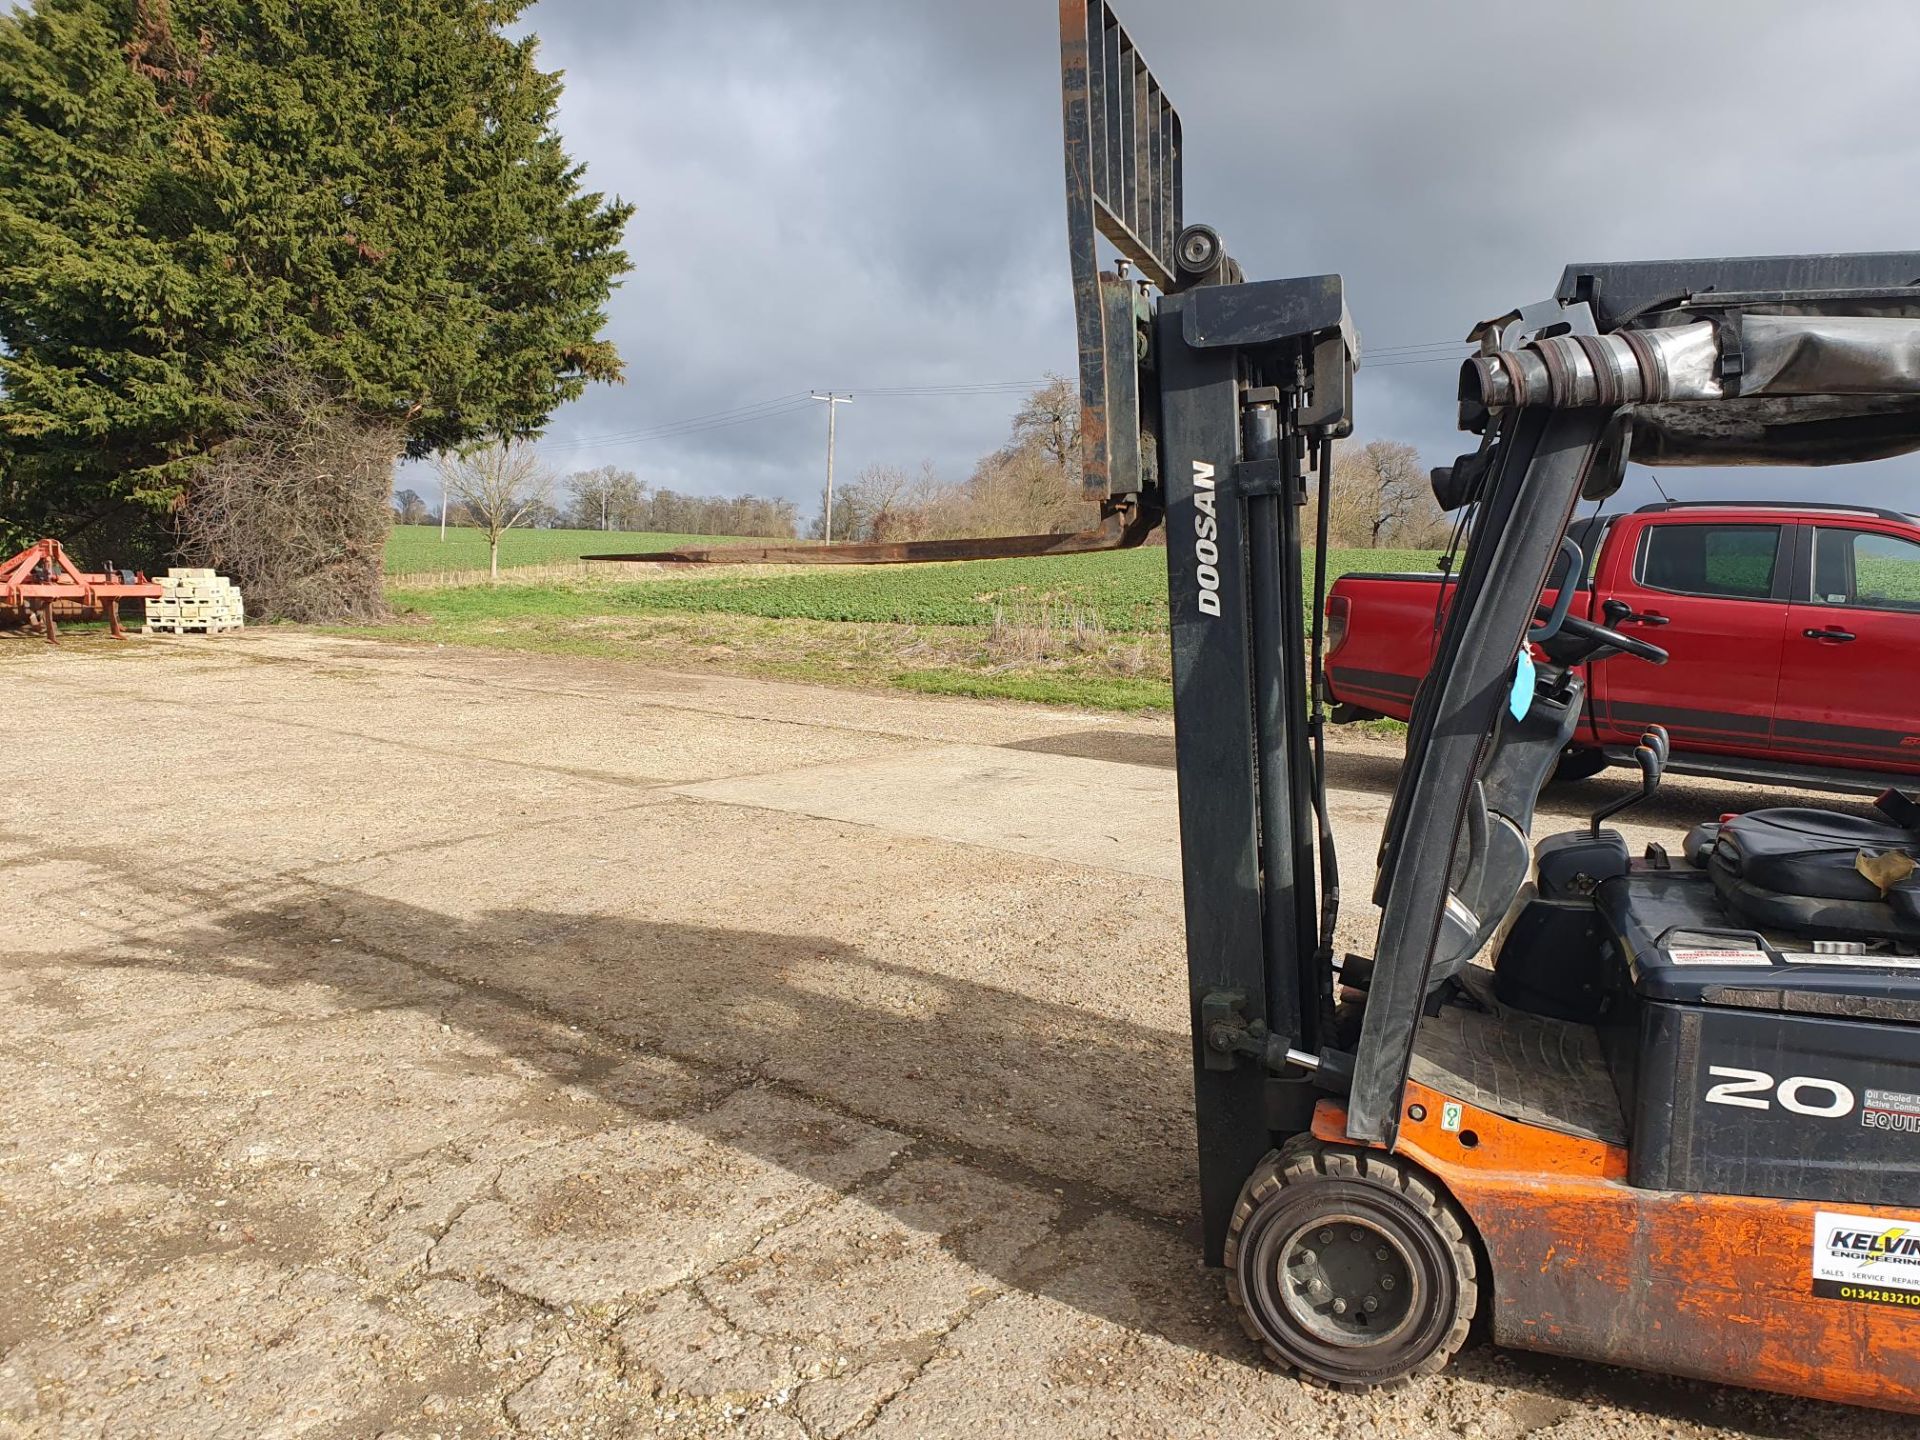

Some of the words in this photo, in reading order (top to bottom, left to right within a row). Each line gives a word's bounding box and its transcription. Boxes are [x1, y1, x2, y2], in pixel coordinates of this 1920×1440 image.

[1192, 460, 1221, 618] DOOSAN
[1705, 1065, 1855, 1118] 20
[1866, 1090, 1879, 1099] Oil
[1882, 1092, 1911, 1103] Cooled
[1866, 1099, 1890, 1109] Active
[1831, 1230, 1920, 1256] KELVIN
[1831, 1250, 1920, 1266] ENGINEERIN
[1821, 1268, 1844, 1277] SALES
[1852, 1272, 1885, 1282] SERVICE
